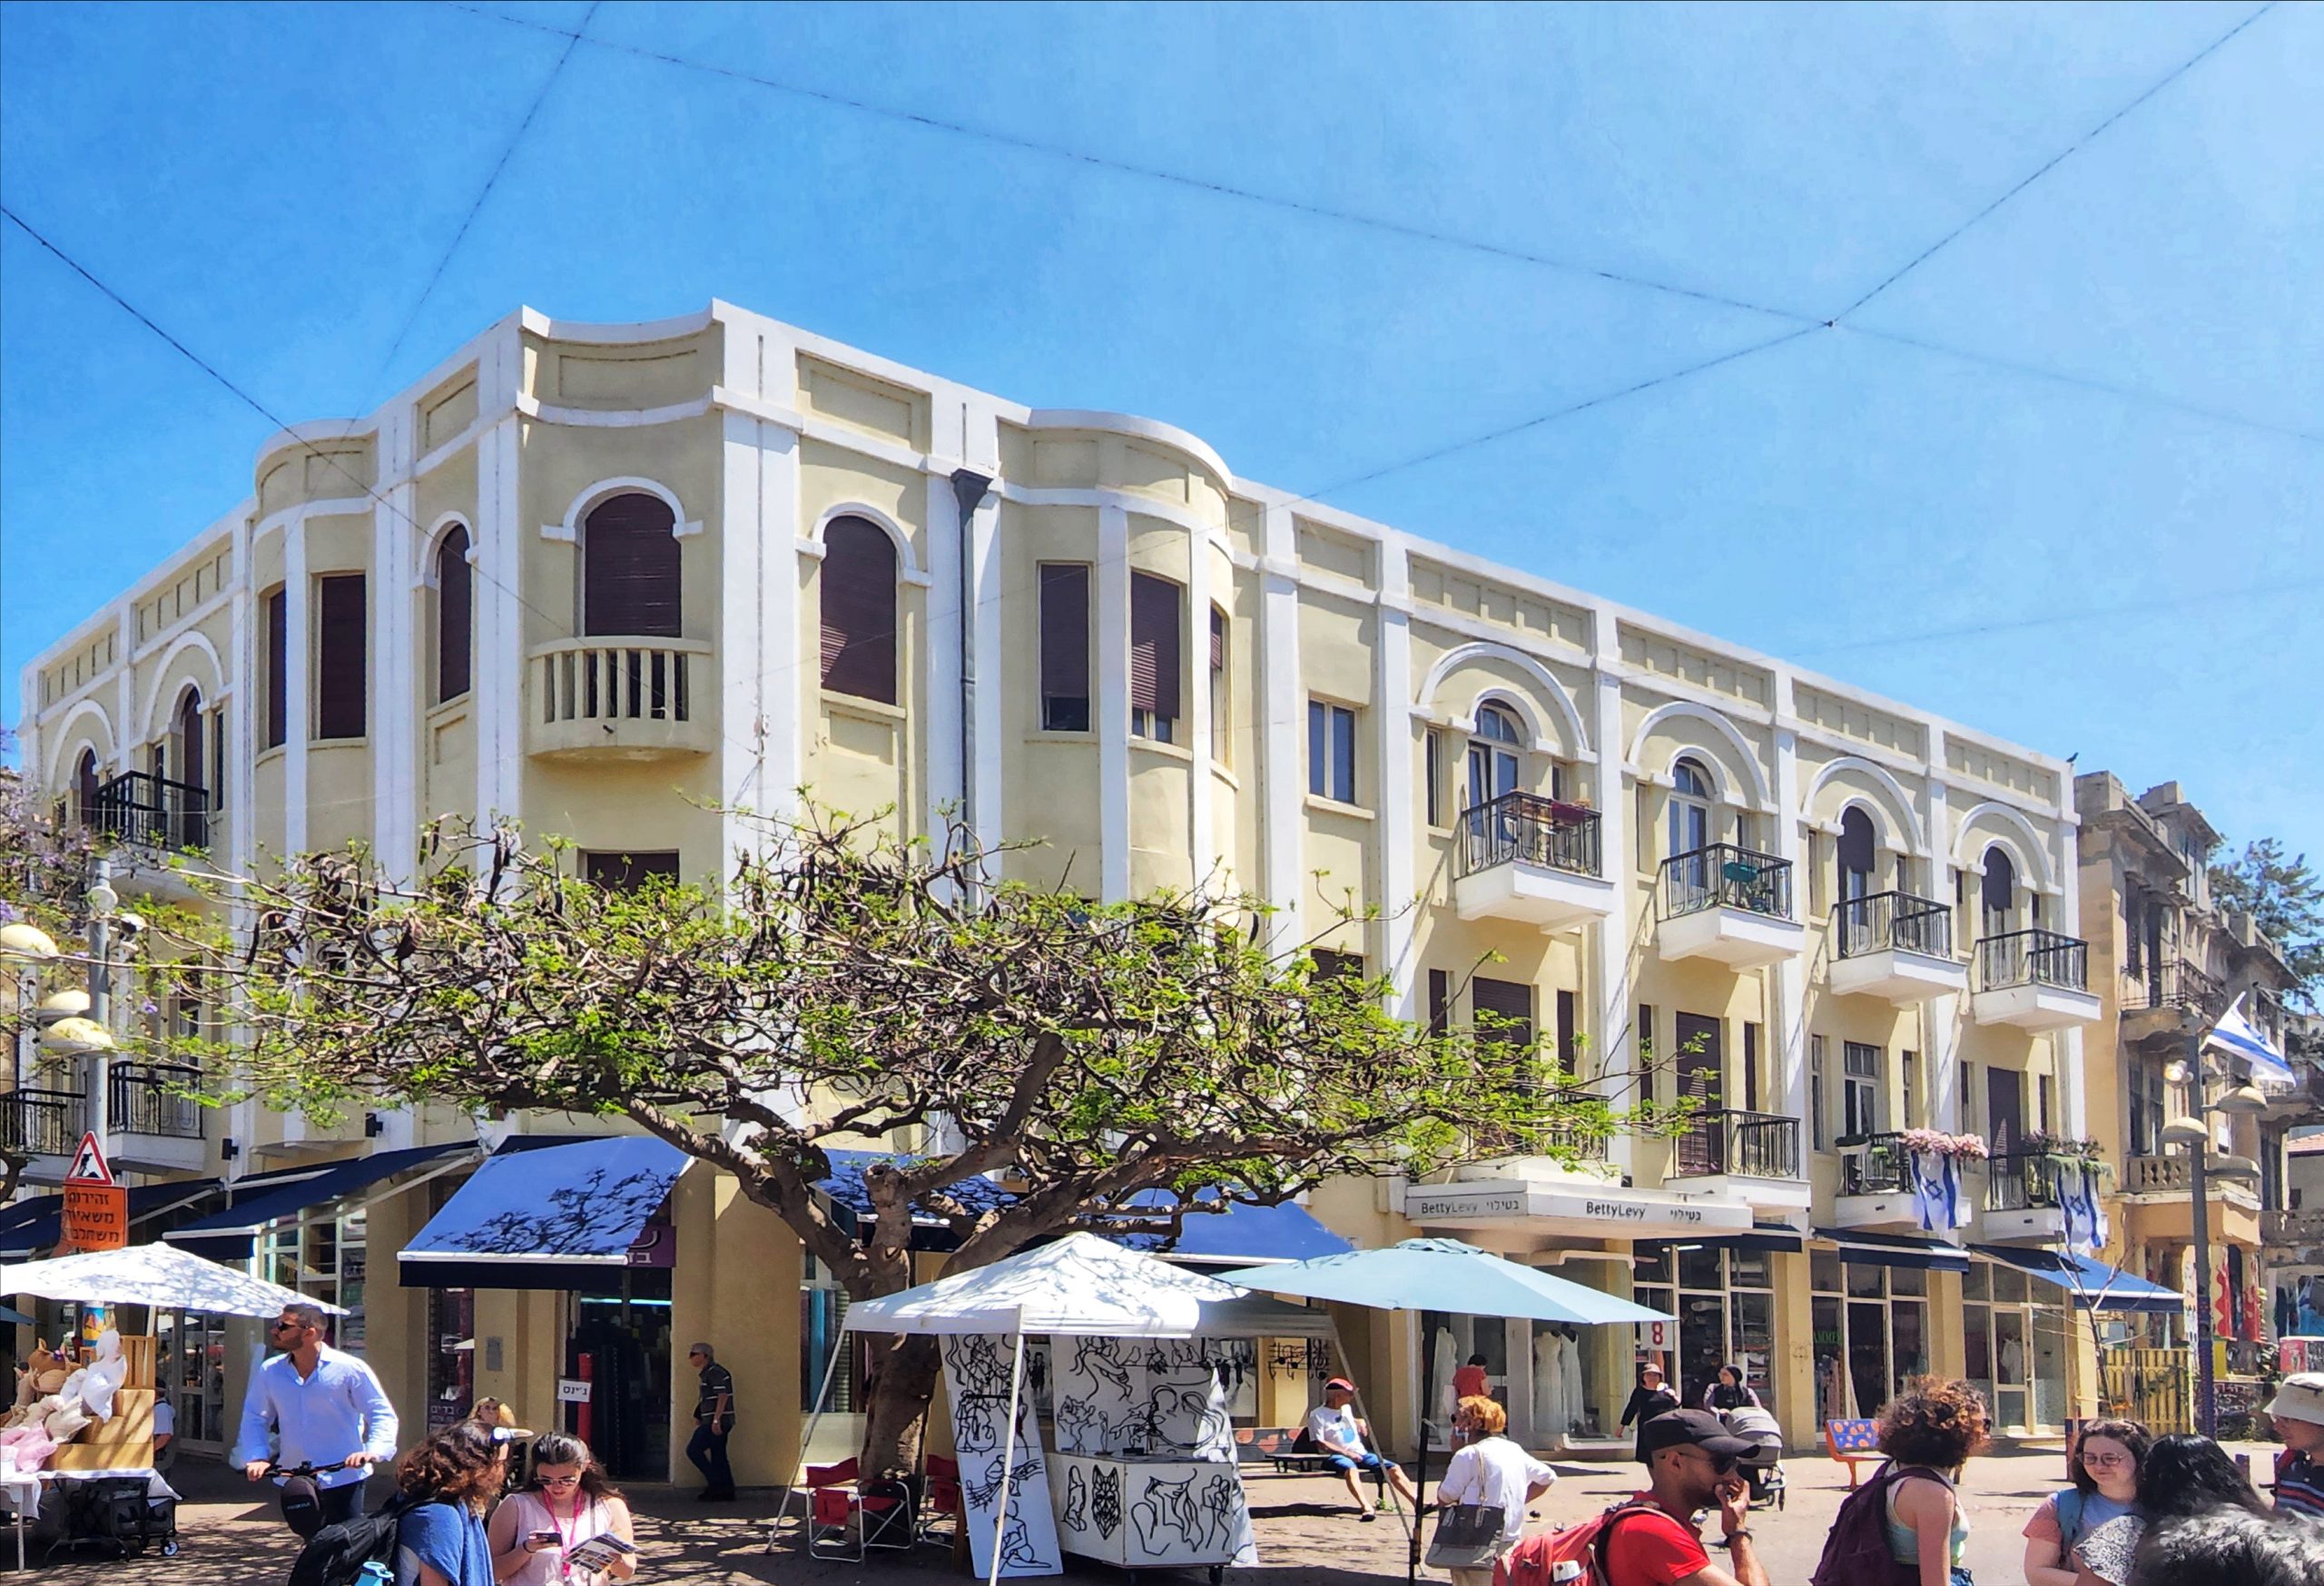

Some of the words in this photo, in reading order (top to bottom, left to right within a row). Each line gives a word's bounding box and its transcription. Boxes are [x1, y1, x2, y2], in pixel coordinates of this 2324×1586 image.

[68, 1191, 109, 1205] זהירות
[1422, 1202, 1478, 1215] BettyLevy
[1586, 1201, 1646, 1219] BettyLevy
[1651, 1321, 1663, 1345] 8
